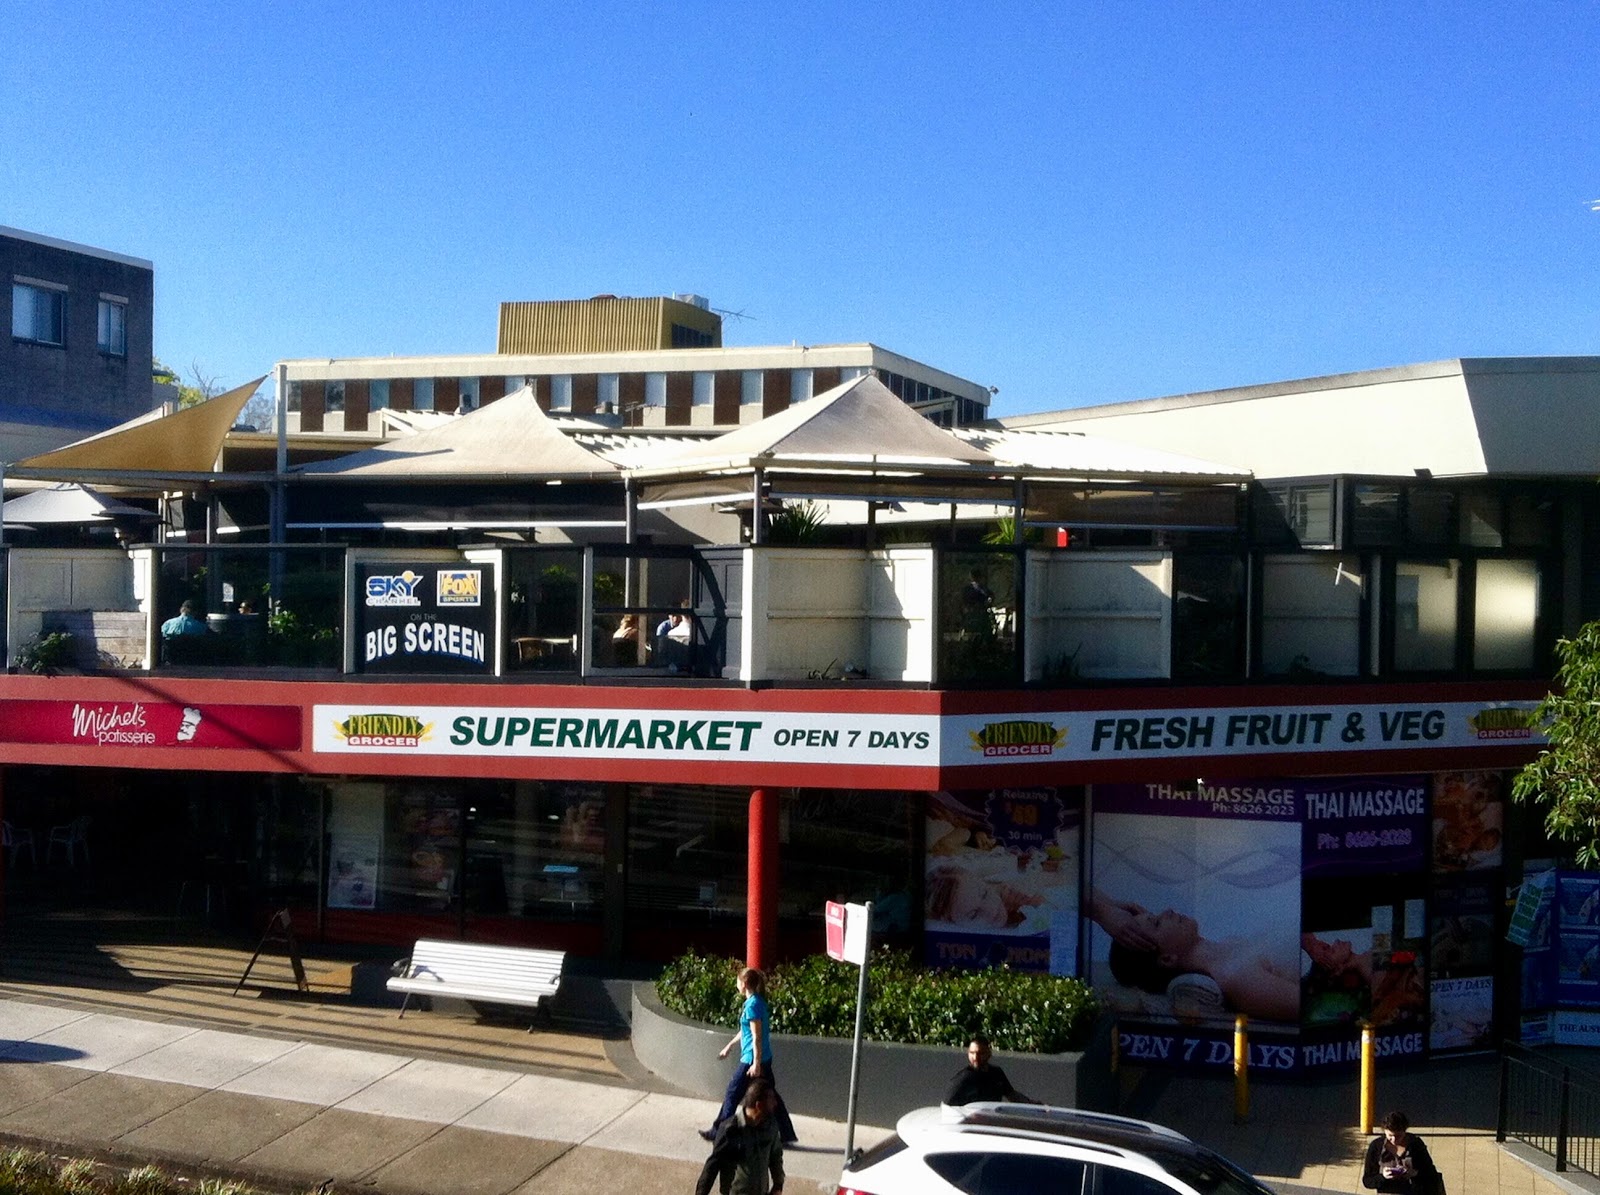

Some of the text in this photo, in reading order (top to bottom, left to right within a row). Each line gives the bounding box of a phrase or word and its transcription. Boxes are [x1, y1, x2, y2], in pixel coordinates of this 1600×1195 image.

[366, 574, 424, 598] SKY
[442, 577, 478, 596] FOX
[410, 613, 437, 621] ON THE
[366, 622, 485, 663] BIG SCREEN
[72, 703, 147, 738] Michel's
[349, 715, 421, 736] FRIENDLY
[1091, 710, 1445, 751] FRESH FRUIT & VEG
[98, 730, 156, 746] patisserie
[349, 736, 418, 746] GROCER
[449, 715, 930, 751] SUPERMARKET OPEN 7 DAYS
[985, 721, 1054, 744] FRIENDLY
[1479, 729, 1530, 739] GROCER
[985, 744, 1051, 756] GROCER
[1197, 785, 1295, 805] MASSAGE
[1305, 788, 1425, 819] THAI MASSAGE
[1212, 802, 1231, 813] Ph:
[1263, 804, 1295, 816] 2023
[1023, 831, 1043, 841] min
[1118, 1033, 1174, 1059] PEN
[1183, 1038, 1200, 1062] 7
[1302, 1032, 1424, 1067] THAI MSSAGE
